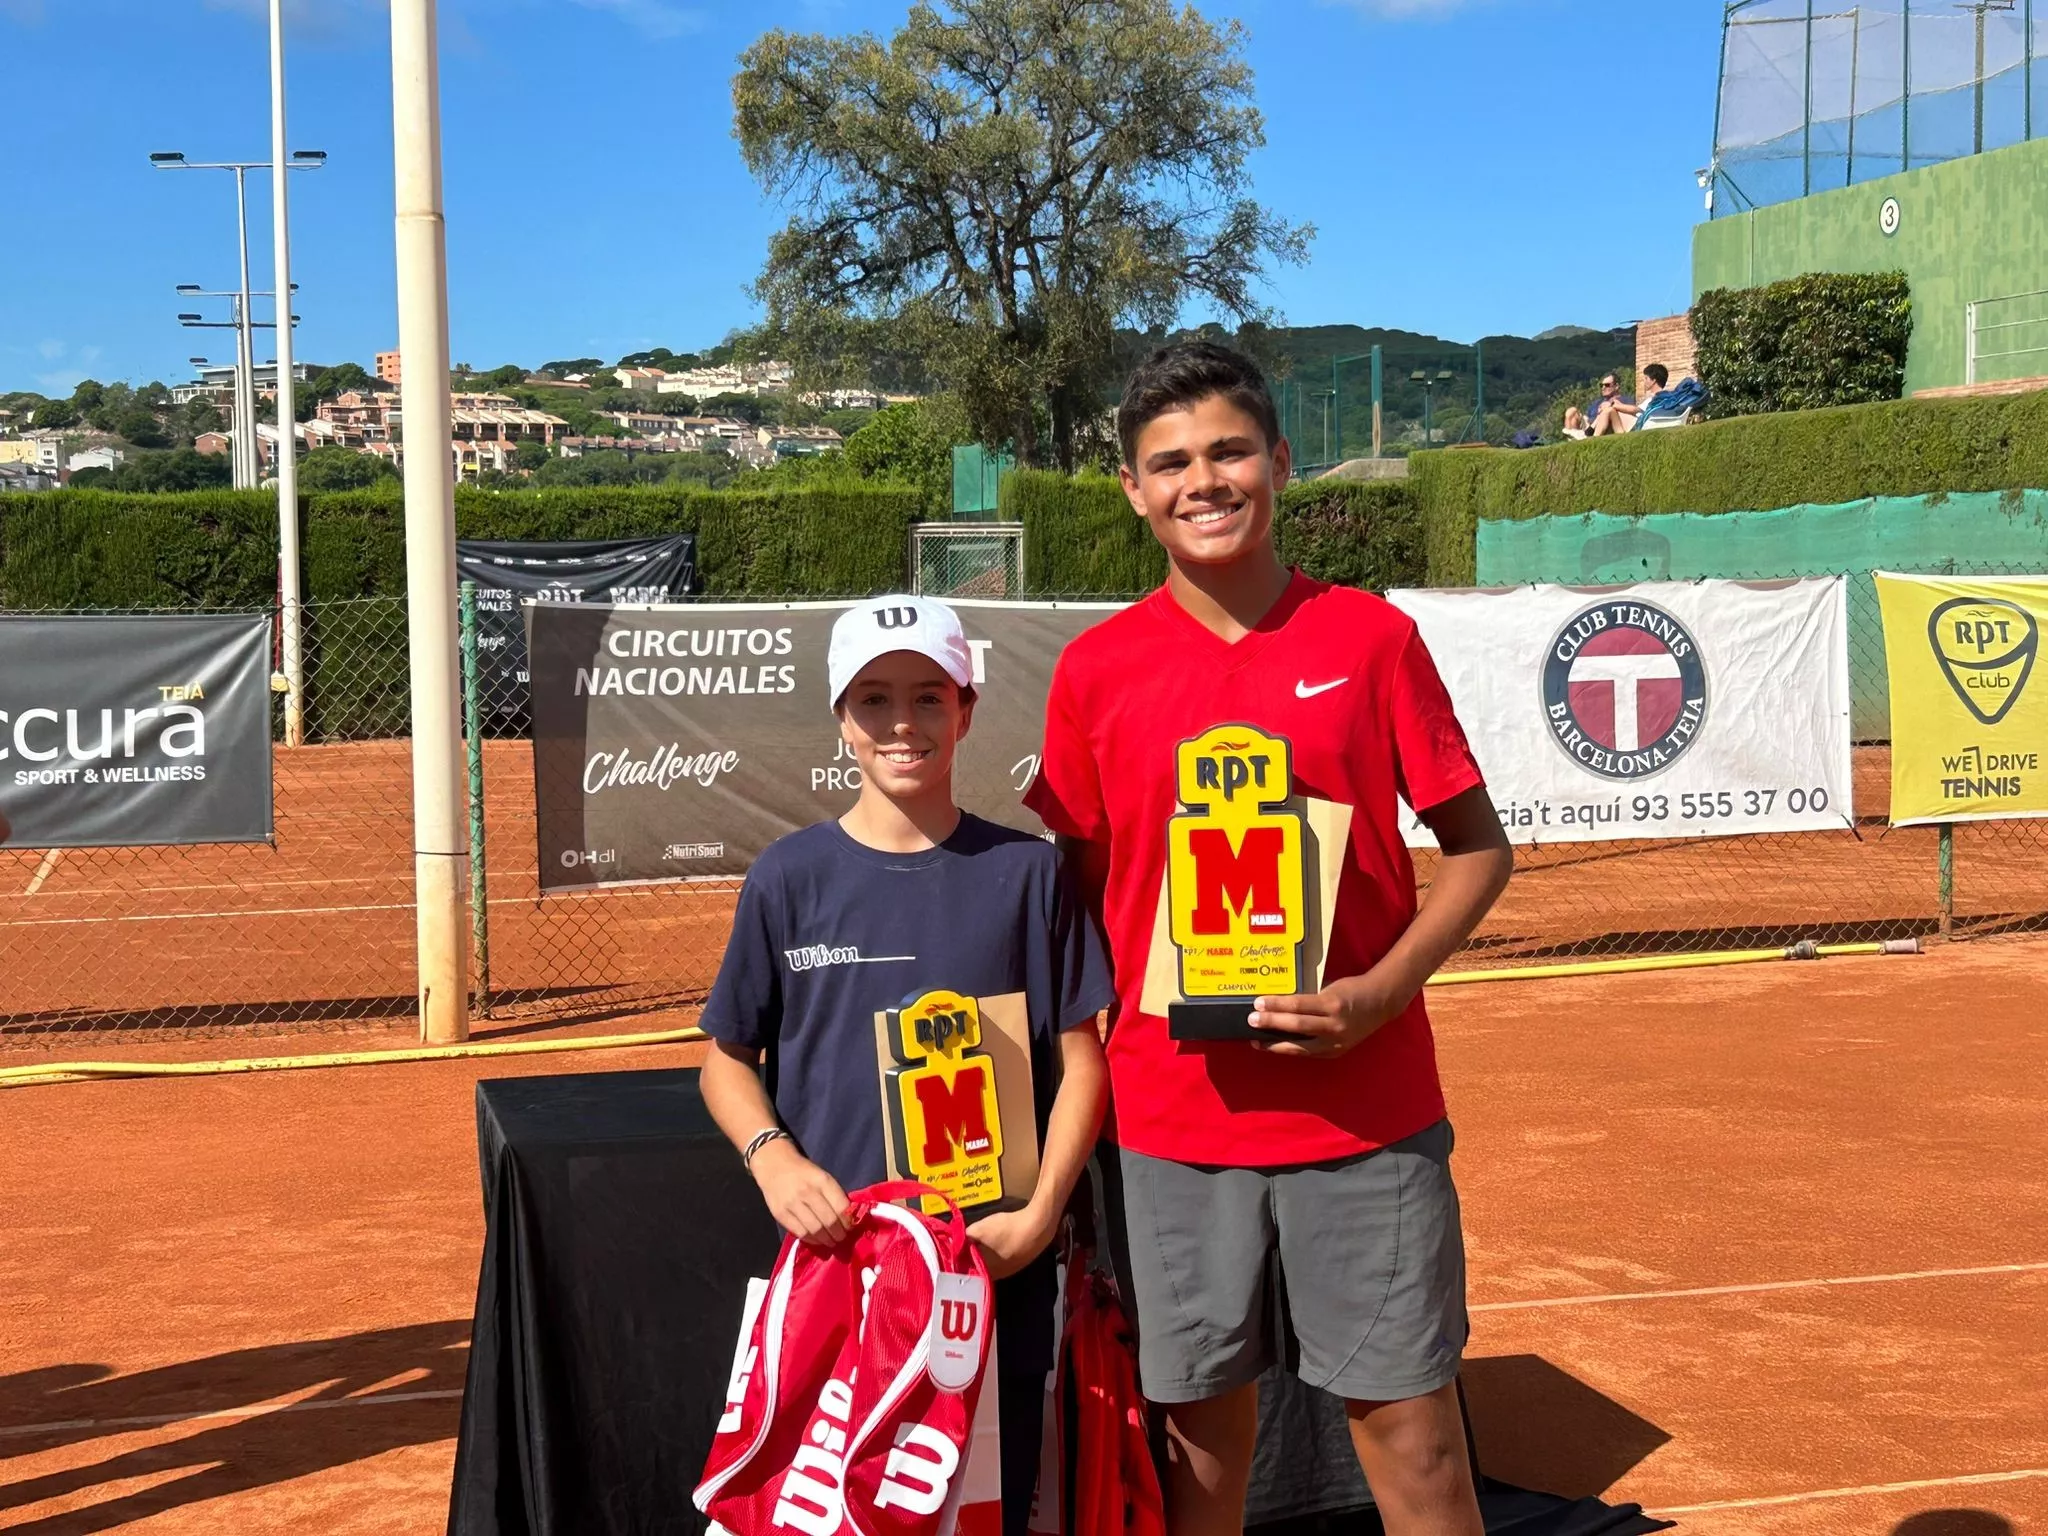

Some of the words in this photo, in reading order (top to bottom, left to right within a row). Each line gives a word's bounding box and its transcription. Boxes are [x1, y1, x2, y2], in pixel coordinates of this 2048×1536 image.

[1885, 205, 1894, 227] 3
[608, 628, 793, 658] CIRCUITOS
[1556, 610, 1608, 662] CLUB
[1611, 605, 1691, 658] TENNIS
[574, 665, 796, 696] NACIONALES
[1967, 672, 2010, 689] club
[14, 768, 79, 786] SPORT
[83, 768, 99, 784] &
[102, 765, 206, 783] WELLNESS
[583, 742, 740, 795] Challenge
[1942, 755, 1972, 773] WE
[1987, 753, 2038, 771] DRIVE
[1941, 776, 2021, 799] TENNIS
[1561, 796, 1620, 830] aquí
[1632, 795, 1669, 821] 93
[1681, 791, 1733, 819] 555
[1743, 789, 1778, 815] 37
[1787, 787, 1829, 812] 00
[1189, 827, 1287, 935] M
[784, 944, 859, 971] Wilson
[914, 1066, 994, 1168] M
